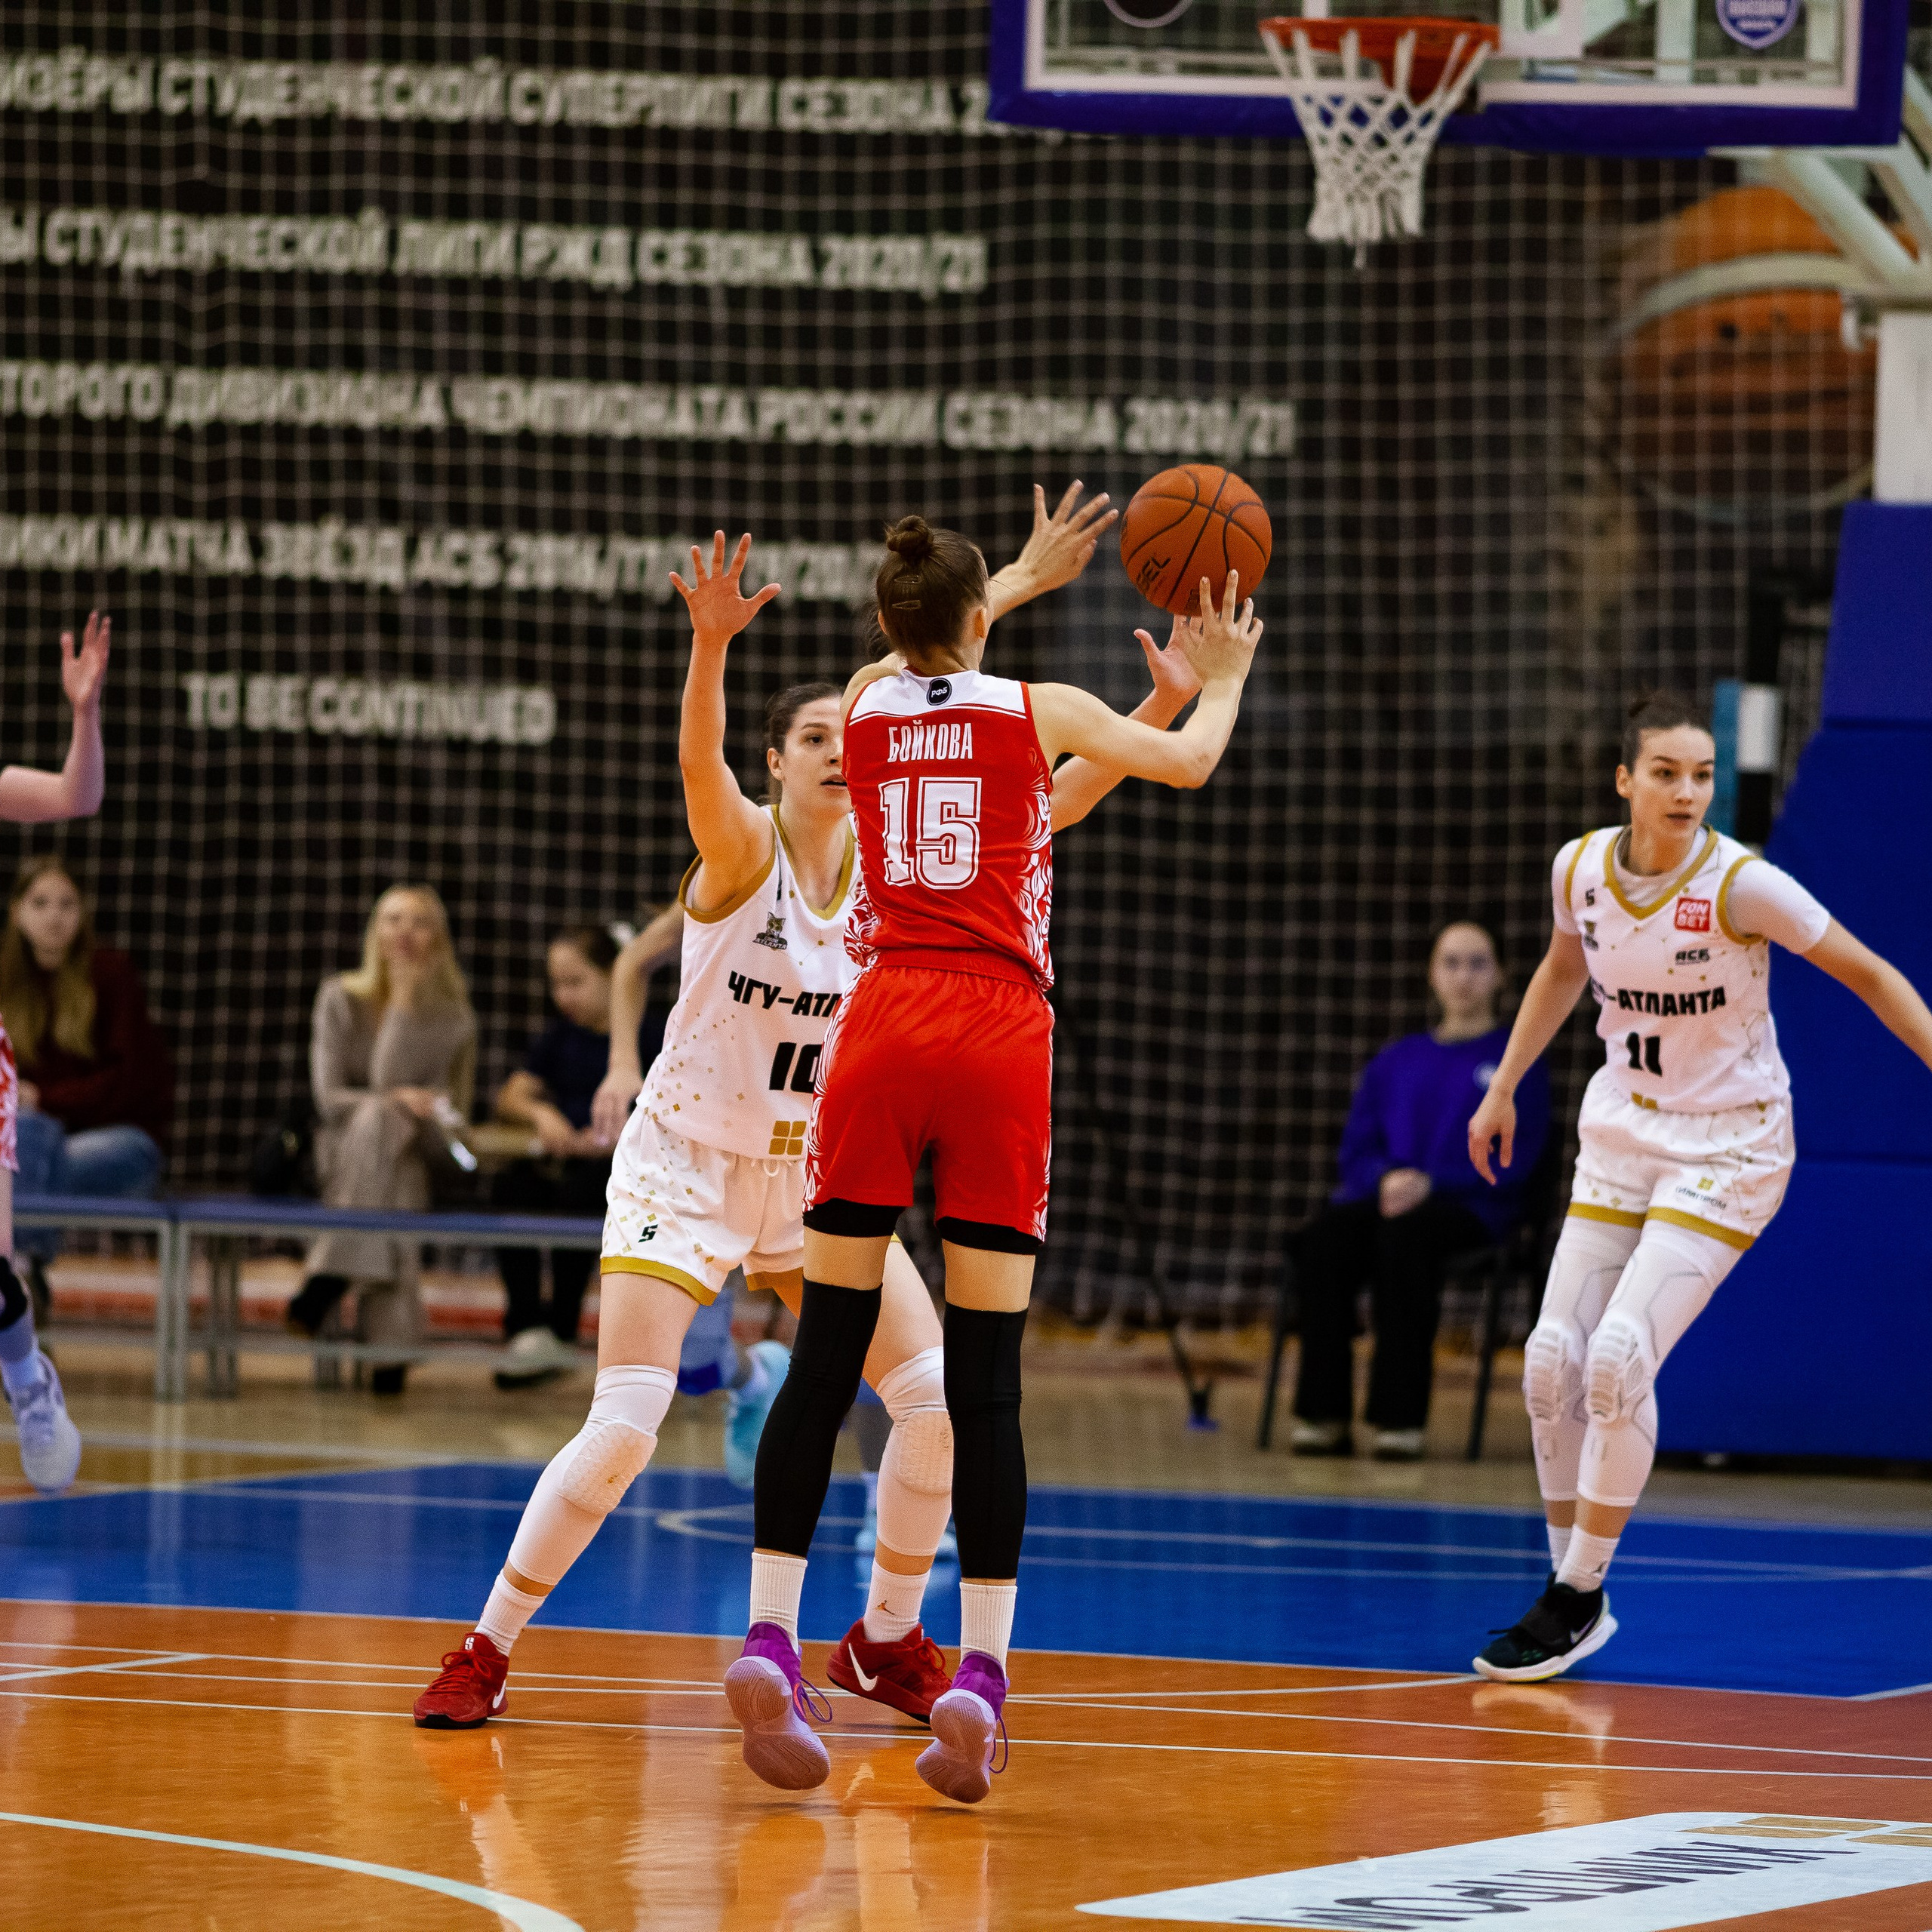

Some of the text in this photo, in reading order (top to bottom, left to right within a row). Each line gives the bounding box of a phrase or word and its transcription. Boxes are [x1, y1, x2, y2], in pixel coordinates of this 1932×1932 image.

[158, 57, 506, 124] СТУДЕНЧЕСКОЙ
[509, 66, 771, 128] СУПЕРЛИГИ
[777, 76, 955, 134] СЕЗОНА
[43, 208, 389, 279] СТУДЕНЧЕСКОЙ
[395, 218, 516, 278] ЛИГИ
[521, 225, 632, 291] РЖД
[636, 229, 814, 287] СЕЗОНА
[820, 235, 986, 298] 2020/21
[165, 368, 446, 430] ДИВИЗИОНА
[451, 374, 751, 442] ЧЕМПИОНАТА
[755, 386, 940, 448] РОССИИ
[945, 392, 1119, 453] СЕЗОНА
[1124, 397, 1296, 462] 2020/21
[106, 517, 255, 576] МАТЧА
[260, 515, 405, 589] ЗВЁЗД
[412, 531, 501, 587] АСБ
[186, 674, 558, 746] TO BE CONTINUED
[888, 720, 973, 763] БОЙКОВА
[878, 777, 983, 891] 15
[755, 938, 787, 949] ATLANTA
[1626, 1032, 1663, 1075] 11
